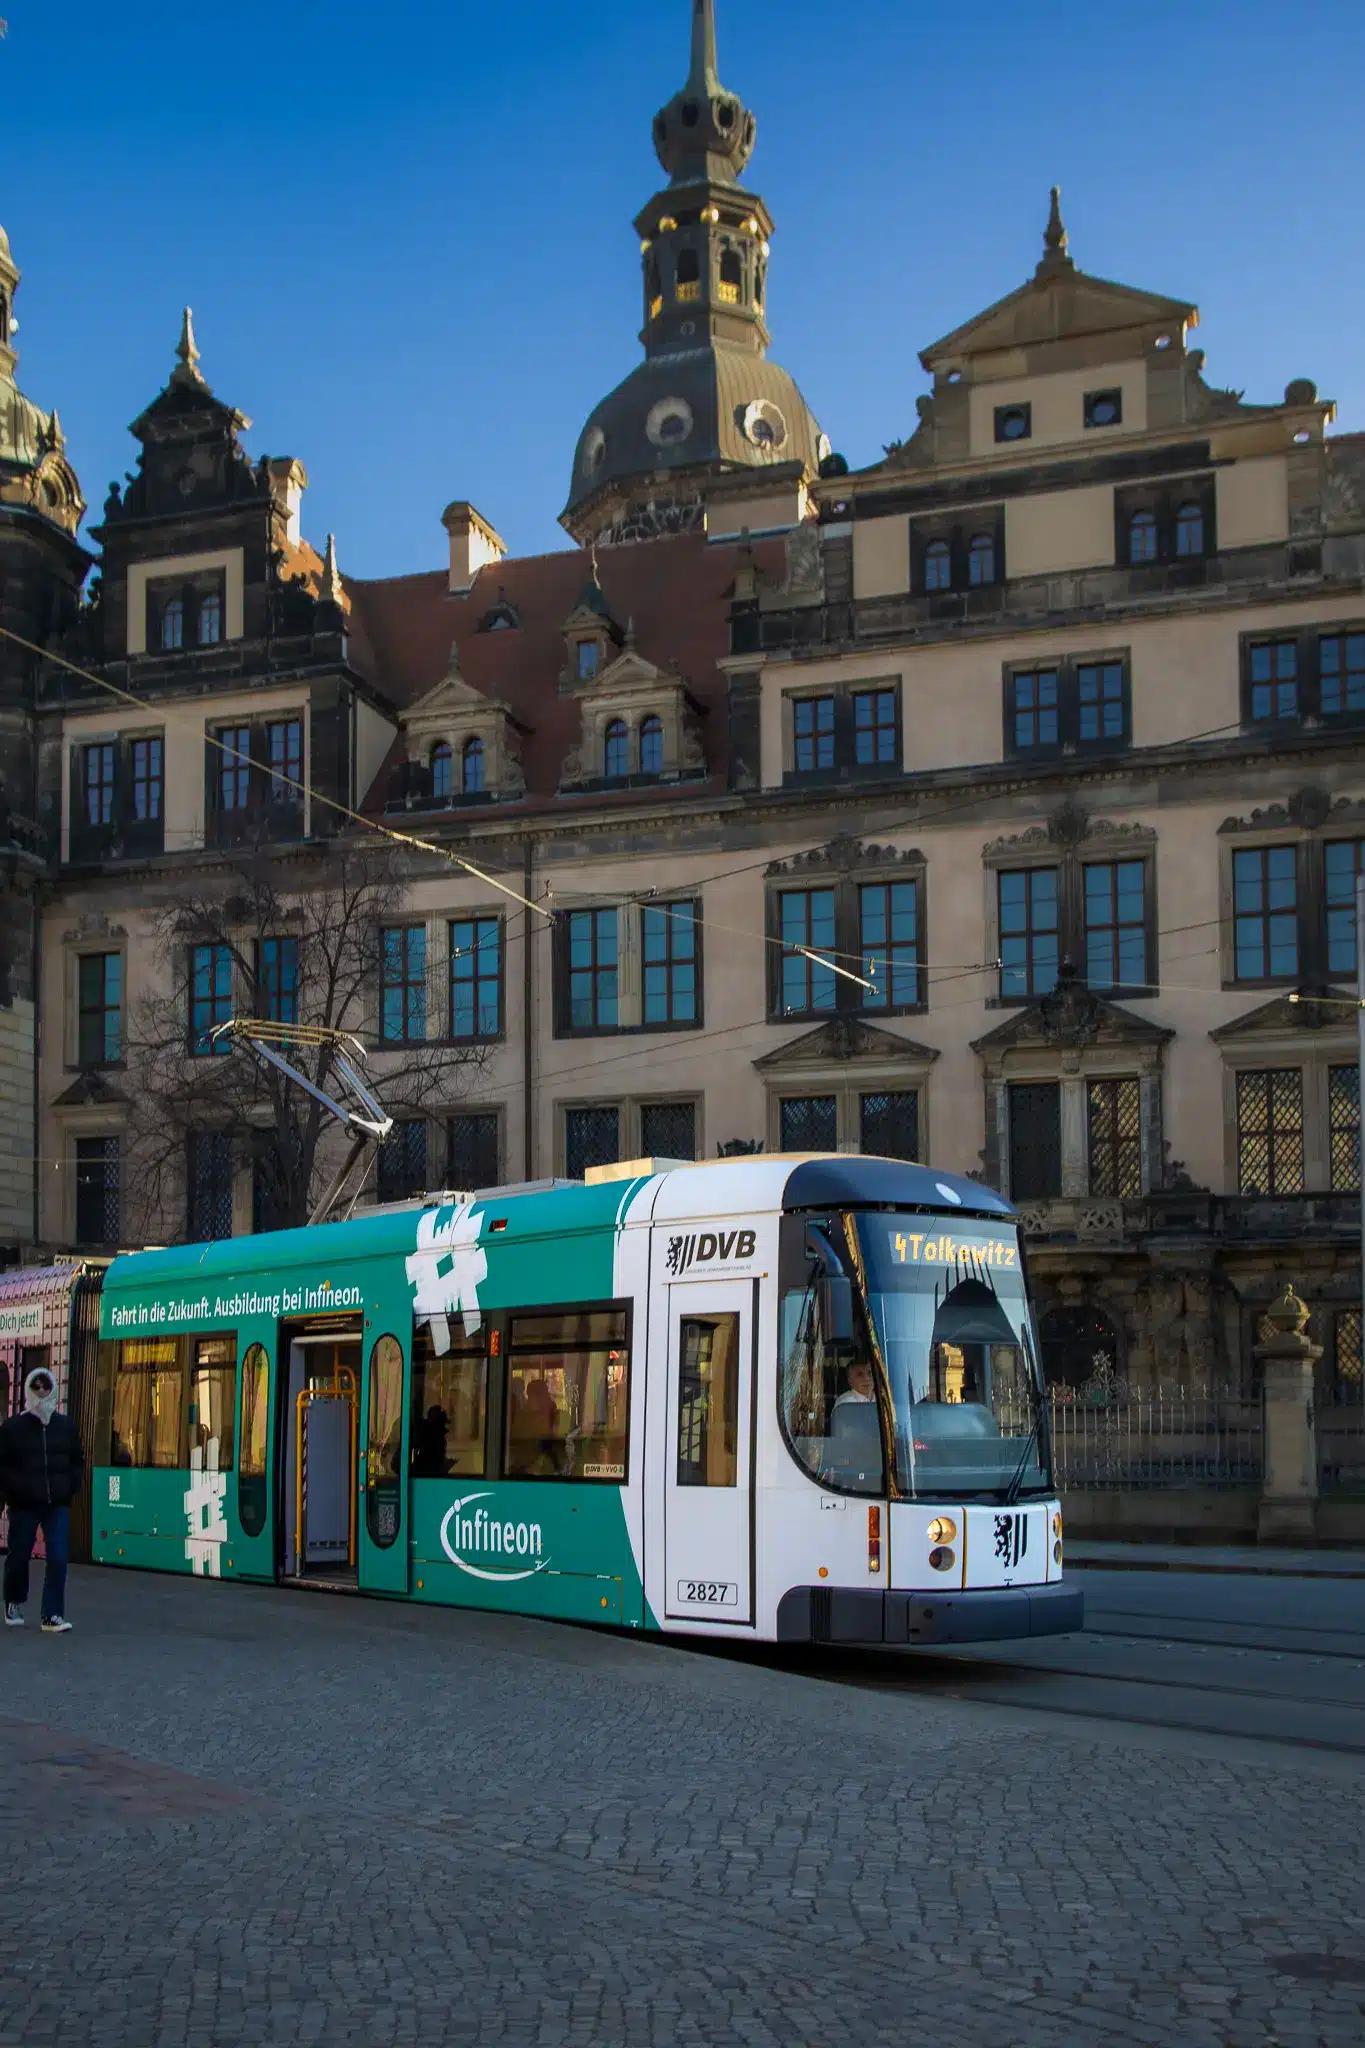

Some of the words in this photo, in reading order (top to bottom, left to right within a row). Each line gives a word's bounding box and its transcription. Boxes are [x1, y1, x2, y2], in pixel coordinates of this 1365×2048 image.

[696, 1230, 757, 1262] DVB
[895, 1232, 907, 1262] 4
[909, 1234, 1016, 1266] Tolkowitz
[111, 1305, 137, 1326] Fahrt
[138, 1304, 148, 1324] in
[150, 1303, 166, 1323] die
[167, 1298, 211, 1321] Zukunft.
[214, 1291, 280, 1318] Ausbildung
[282, 1287, 302, 1312] bei
[304, 1283, 364, 1310] Infineon.
[0, 1312, 17, 1331] Dich
[17, 1309, 39, 1333] jetzt!
[687, 1582, 728, 1602] 2827
